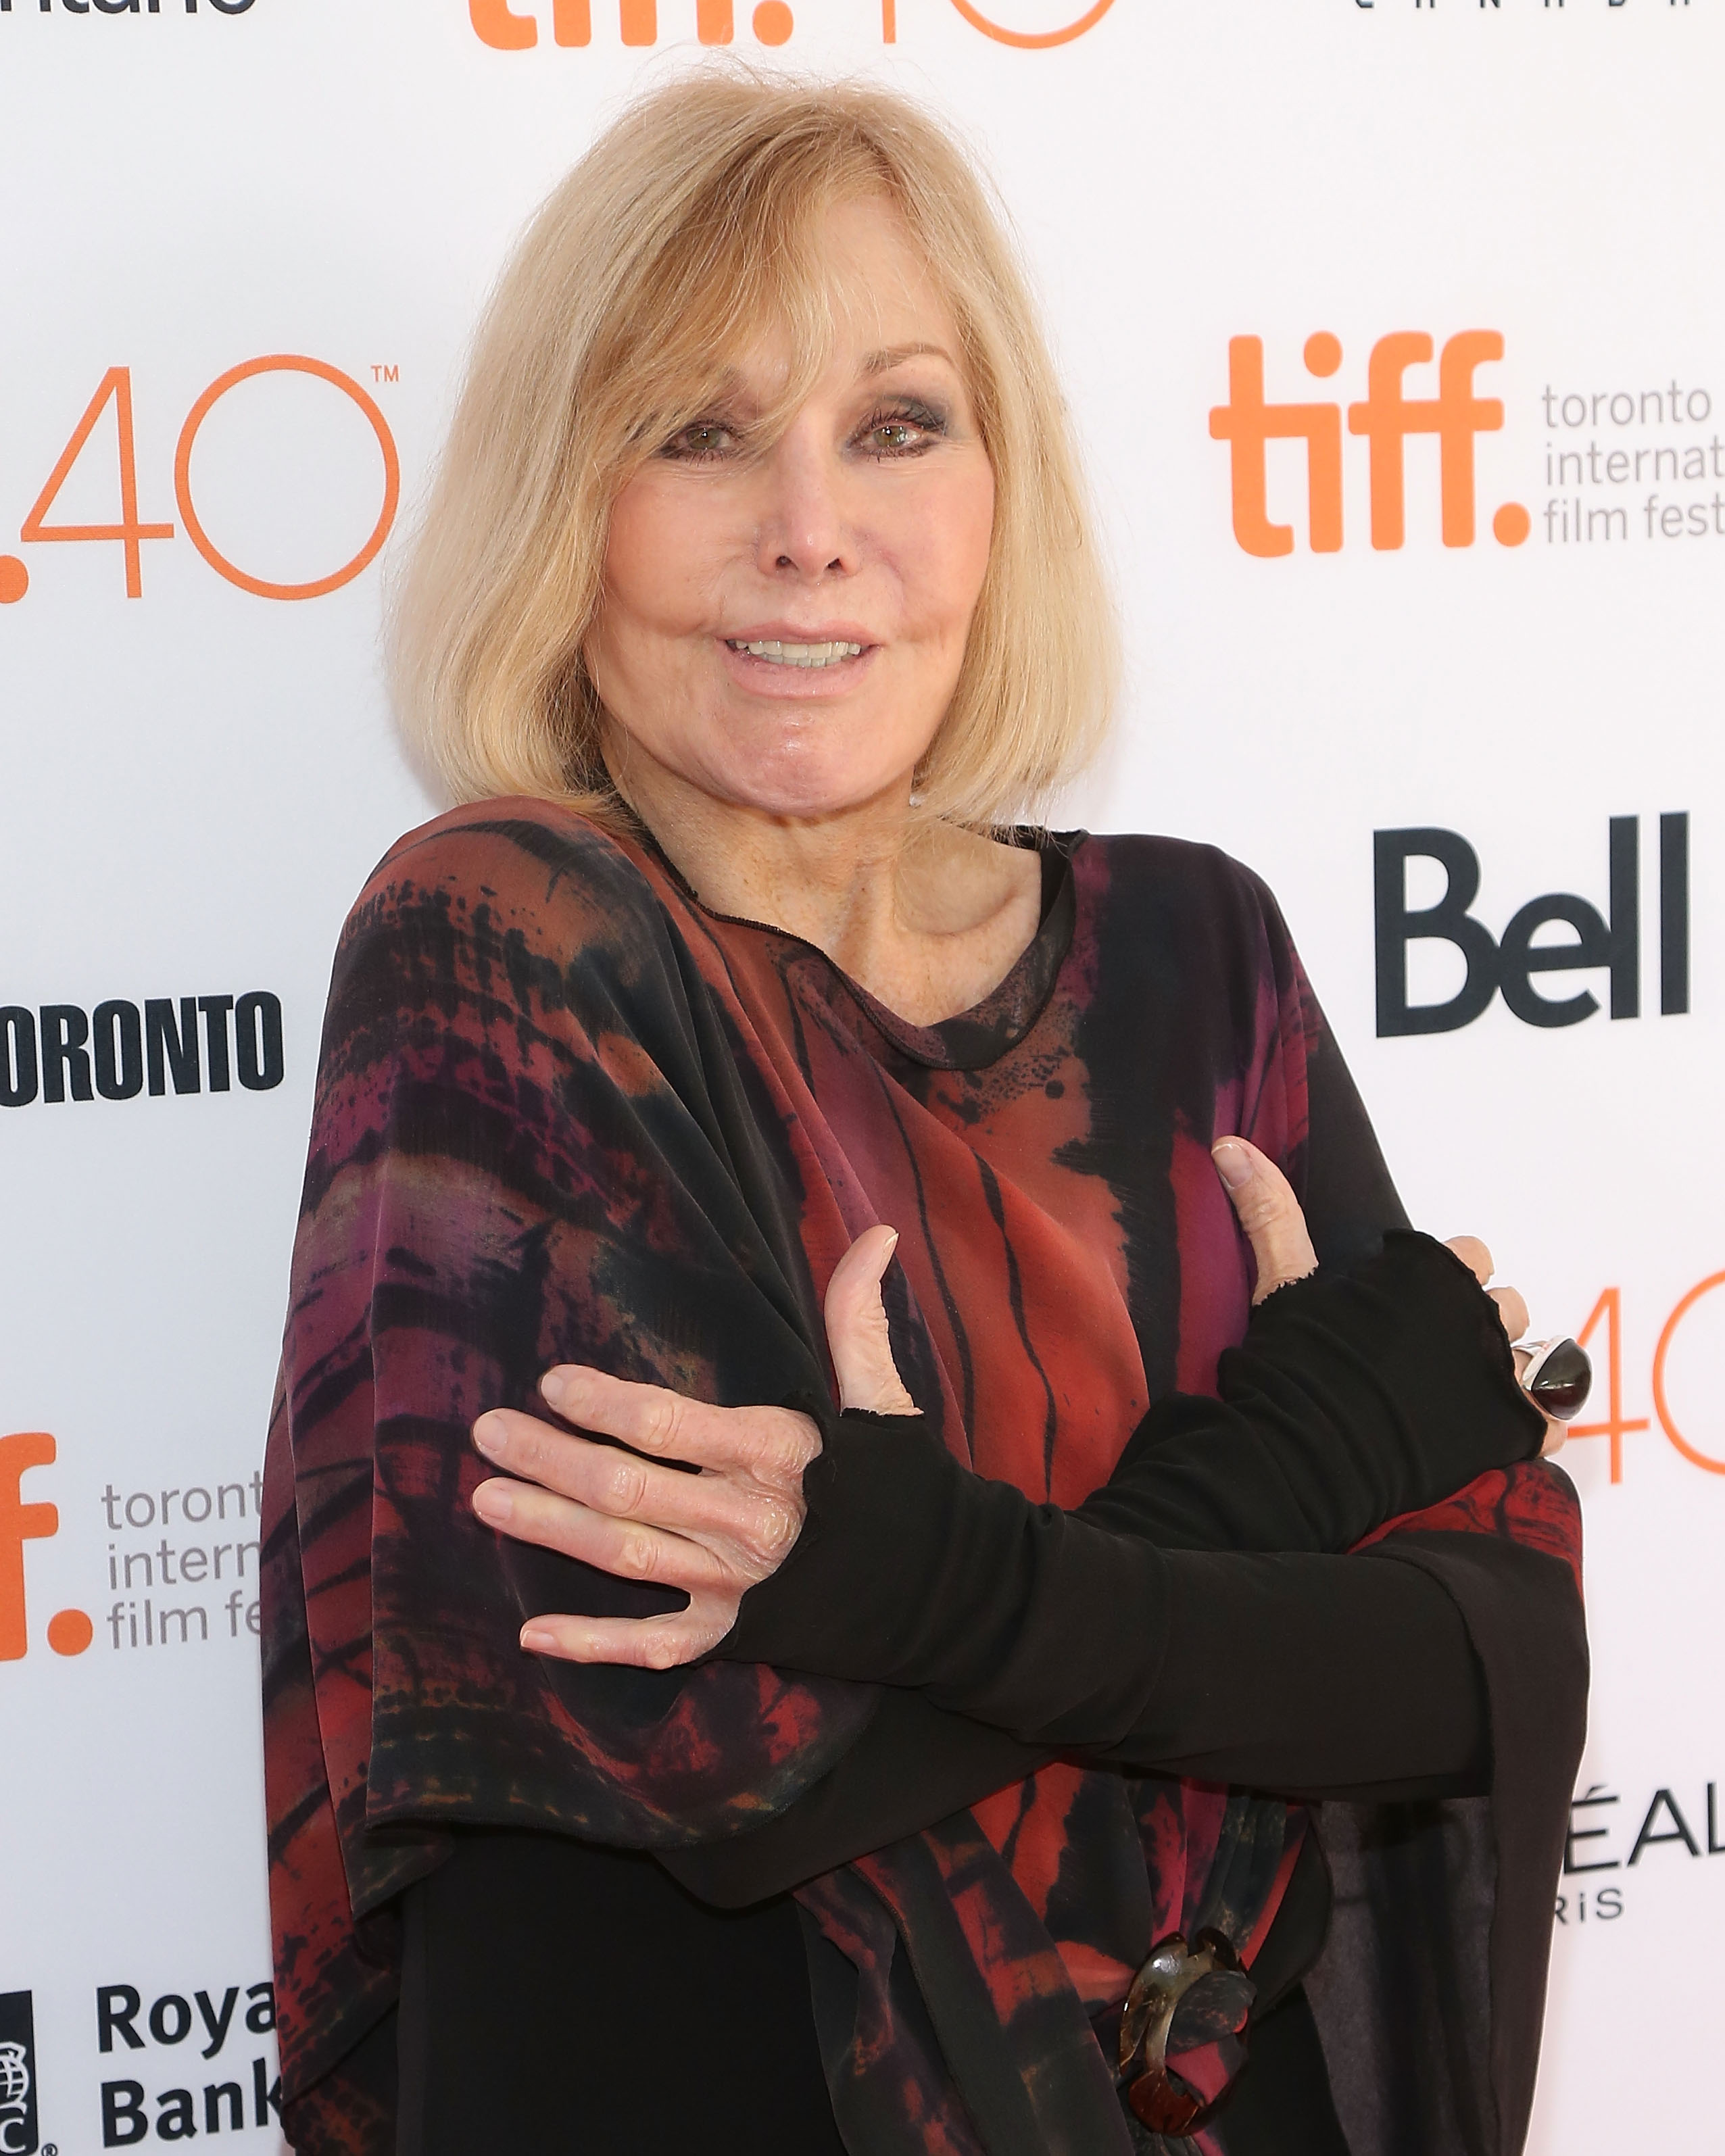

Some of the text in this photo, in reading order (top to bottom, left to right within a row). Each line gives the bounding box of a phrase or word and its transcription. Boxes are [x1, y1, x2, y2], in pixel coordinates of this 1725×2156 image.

[1542, 379, 1711, 427] toronto
[1209, 328, 1530, 558] tiff.
[1547, 435, 1725, 485] internat
[1543, 492, 1725, 543] film fest
[1373, 810, 1690, 1038] Bell
[0, 990, 284, 1107] ORONTO
[101, 1470, 262, 1530] toront
[106, 1599, 208, 1648] film
[97, 1982, 276, 2059] Roya
[101, 2057, 282, 2148] Bank
